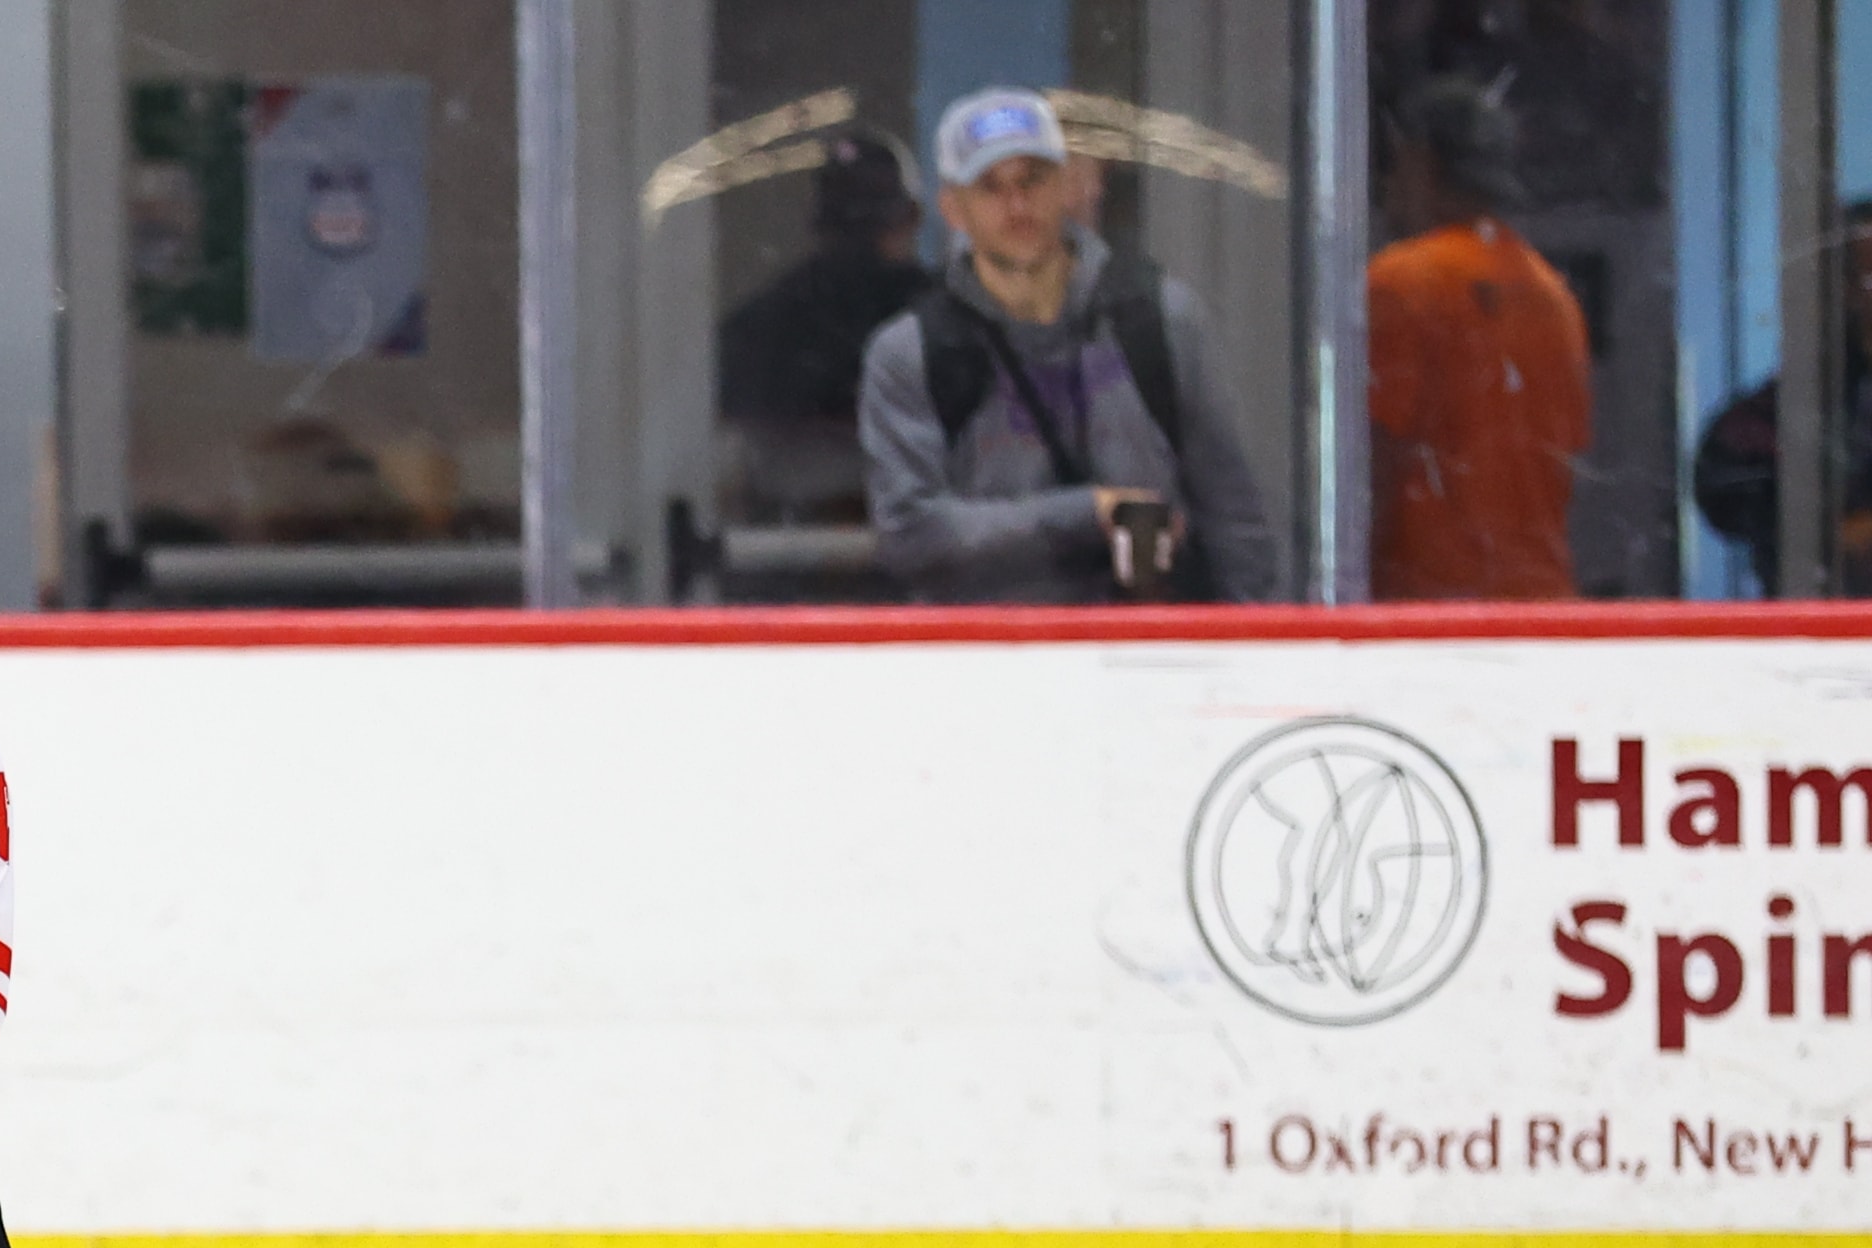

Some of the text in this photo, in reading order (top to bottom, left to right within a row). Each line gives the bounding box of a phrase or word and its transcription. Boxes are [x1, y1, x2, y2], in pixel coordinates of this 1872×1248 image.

[1550, 734, 1872, 850] Ham
[1552, 895, 1872, 1052] Spin
[1218, 1119, 1236, 1170] 1
[1270, 1113, 1501, 1174] Oxford
[1672, 1116, 1820, 1175] New
